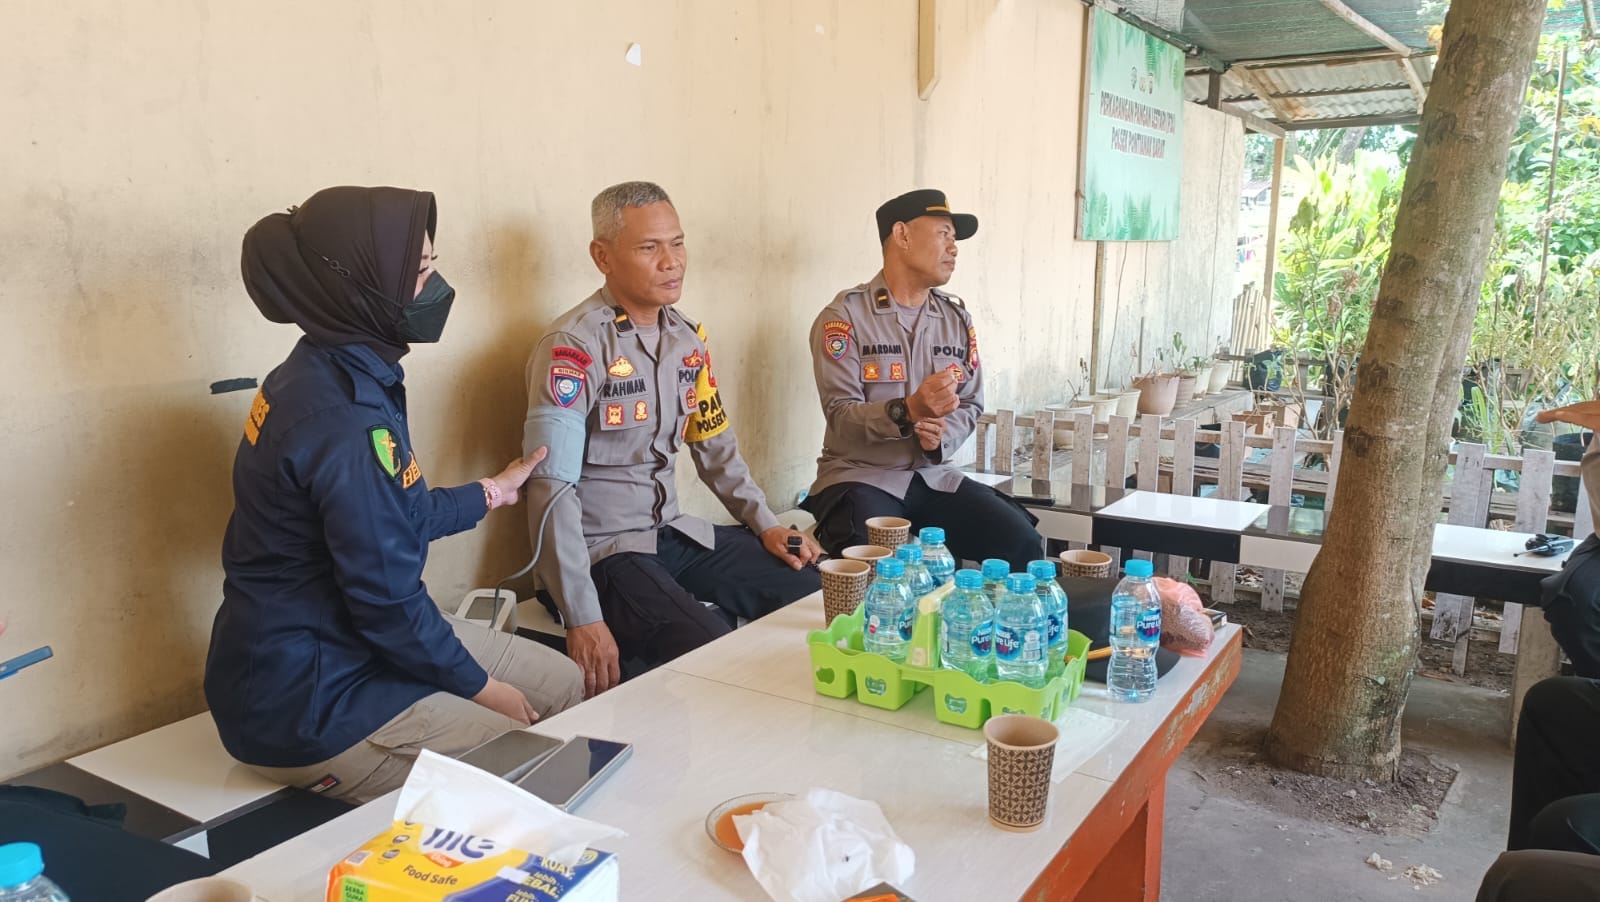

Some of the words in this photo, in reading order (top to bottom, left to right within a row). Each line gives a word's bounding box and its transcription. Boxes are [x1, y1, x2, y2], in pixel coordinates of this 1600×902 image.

[603, 377, 646, 398] RAHMAN
[403, 865, 431, 881] Food
[430, 873, 458, 885] Safe
